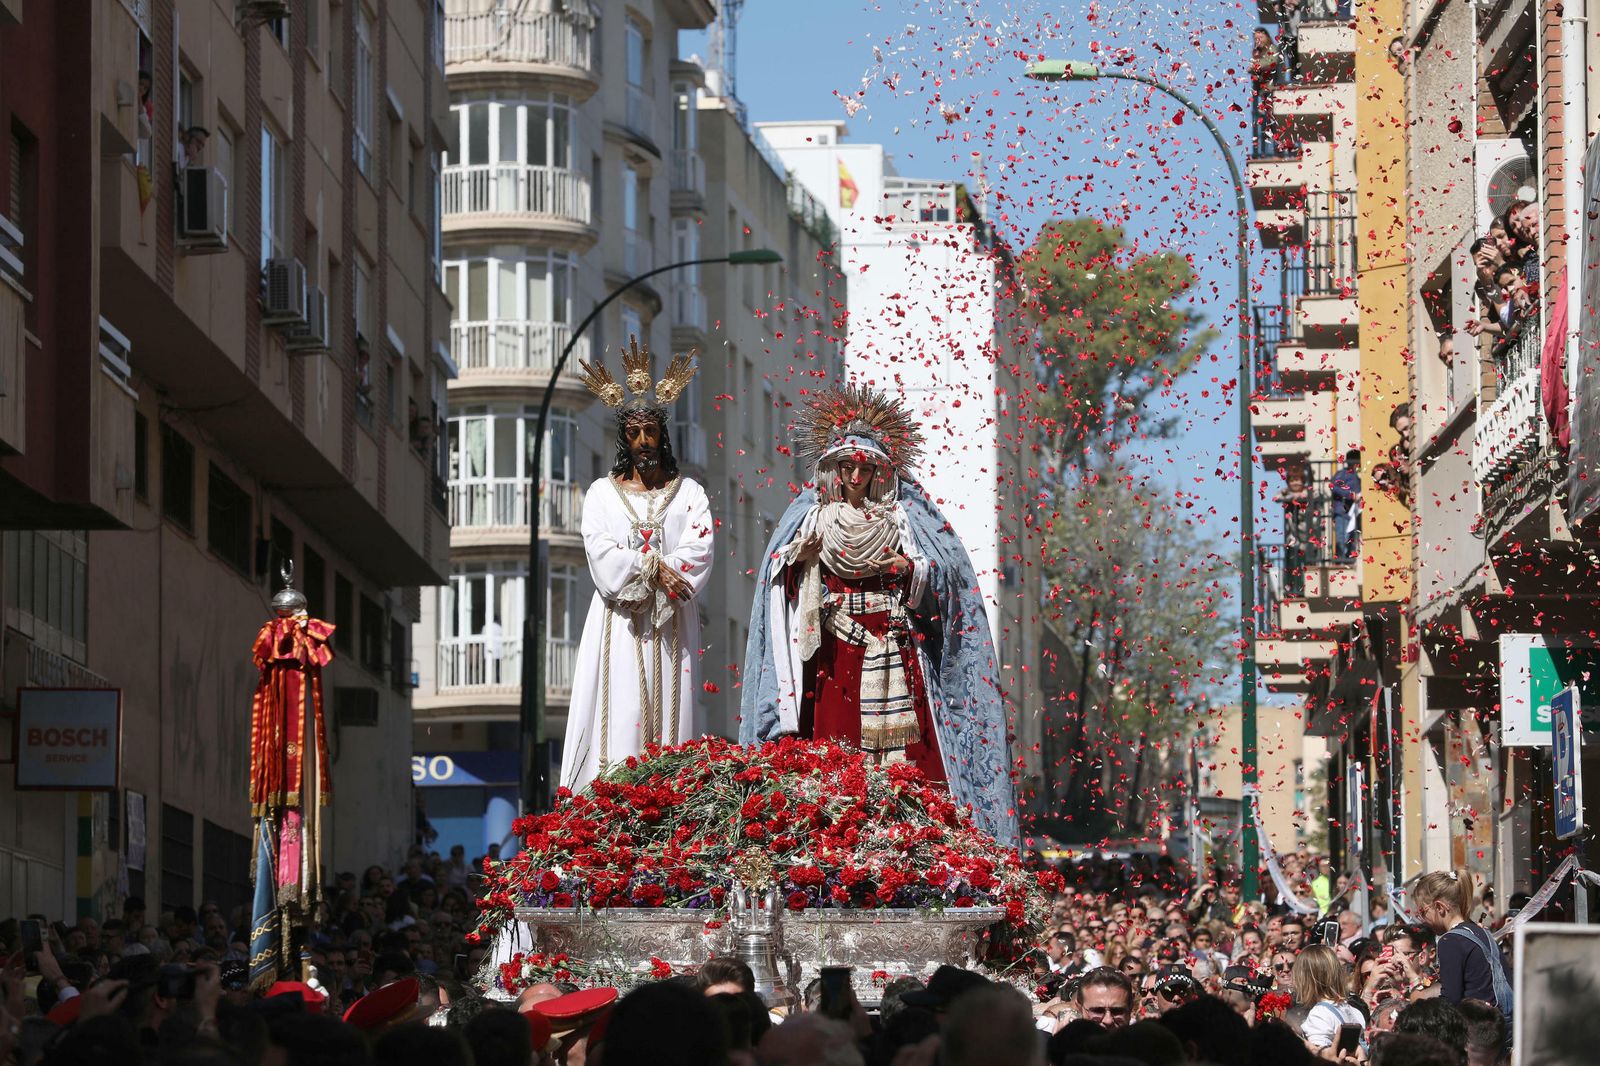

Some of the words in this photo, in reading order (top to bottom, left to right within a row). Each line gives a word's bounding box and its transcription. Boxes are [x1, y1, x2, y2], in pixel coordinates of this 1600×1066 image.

[27, 727, 108, 748] BOSCH
[45, 753, 88, 763] SERVICE
[411, 755, 455, 781] SO
